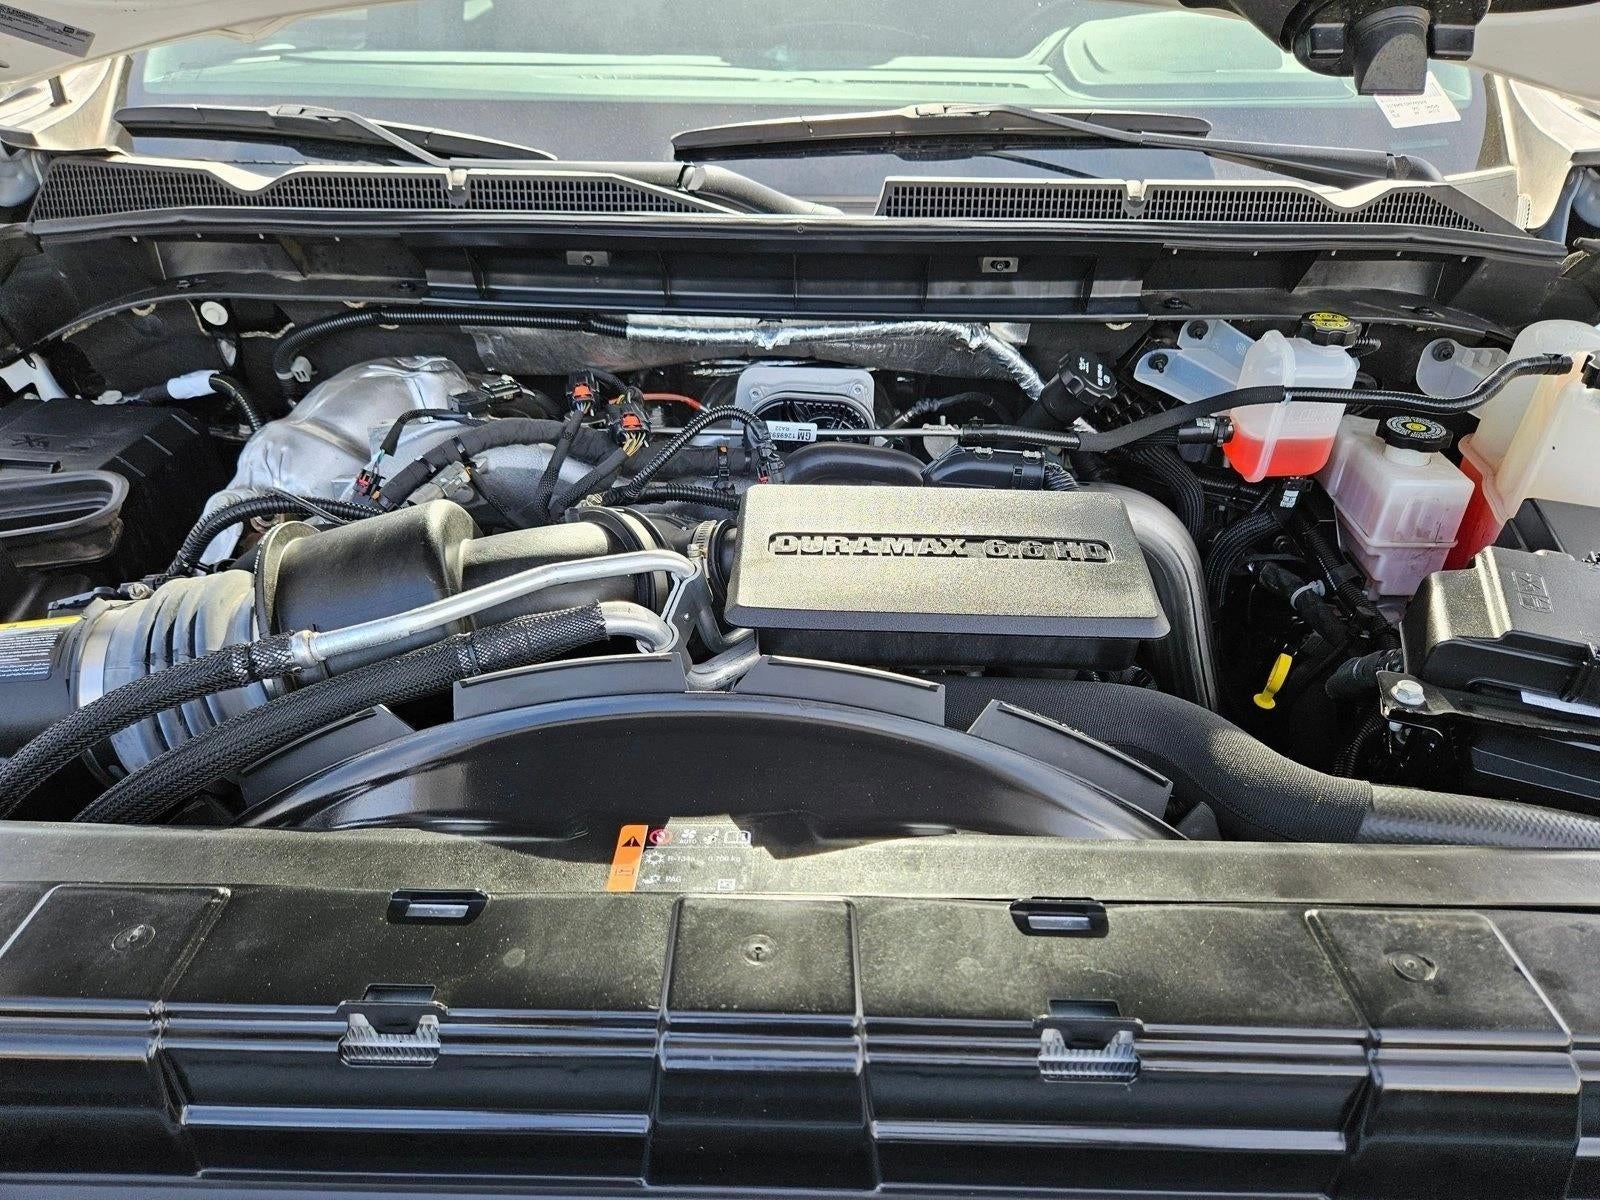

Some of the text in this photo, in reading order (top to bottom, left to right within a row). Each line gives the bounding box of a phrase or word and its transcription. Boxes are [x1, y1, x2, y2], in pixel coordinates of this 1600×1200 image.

[797, 432, 811, 440] GM
[773, 535, 1108, 563] DURAMAX 6.6 HD
[665, 875, 682, 883] PAG
